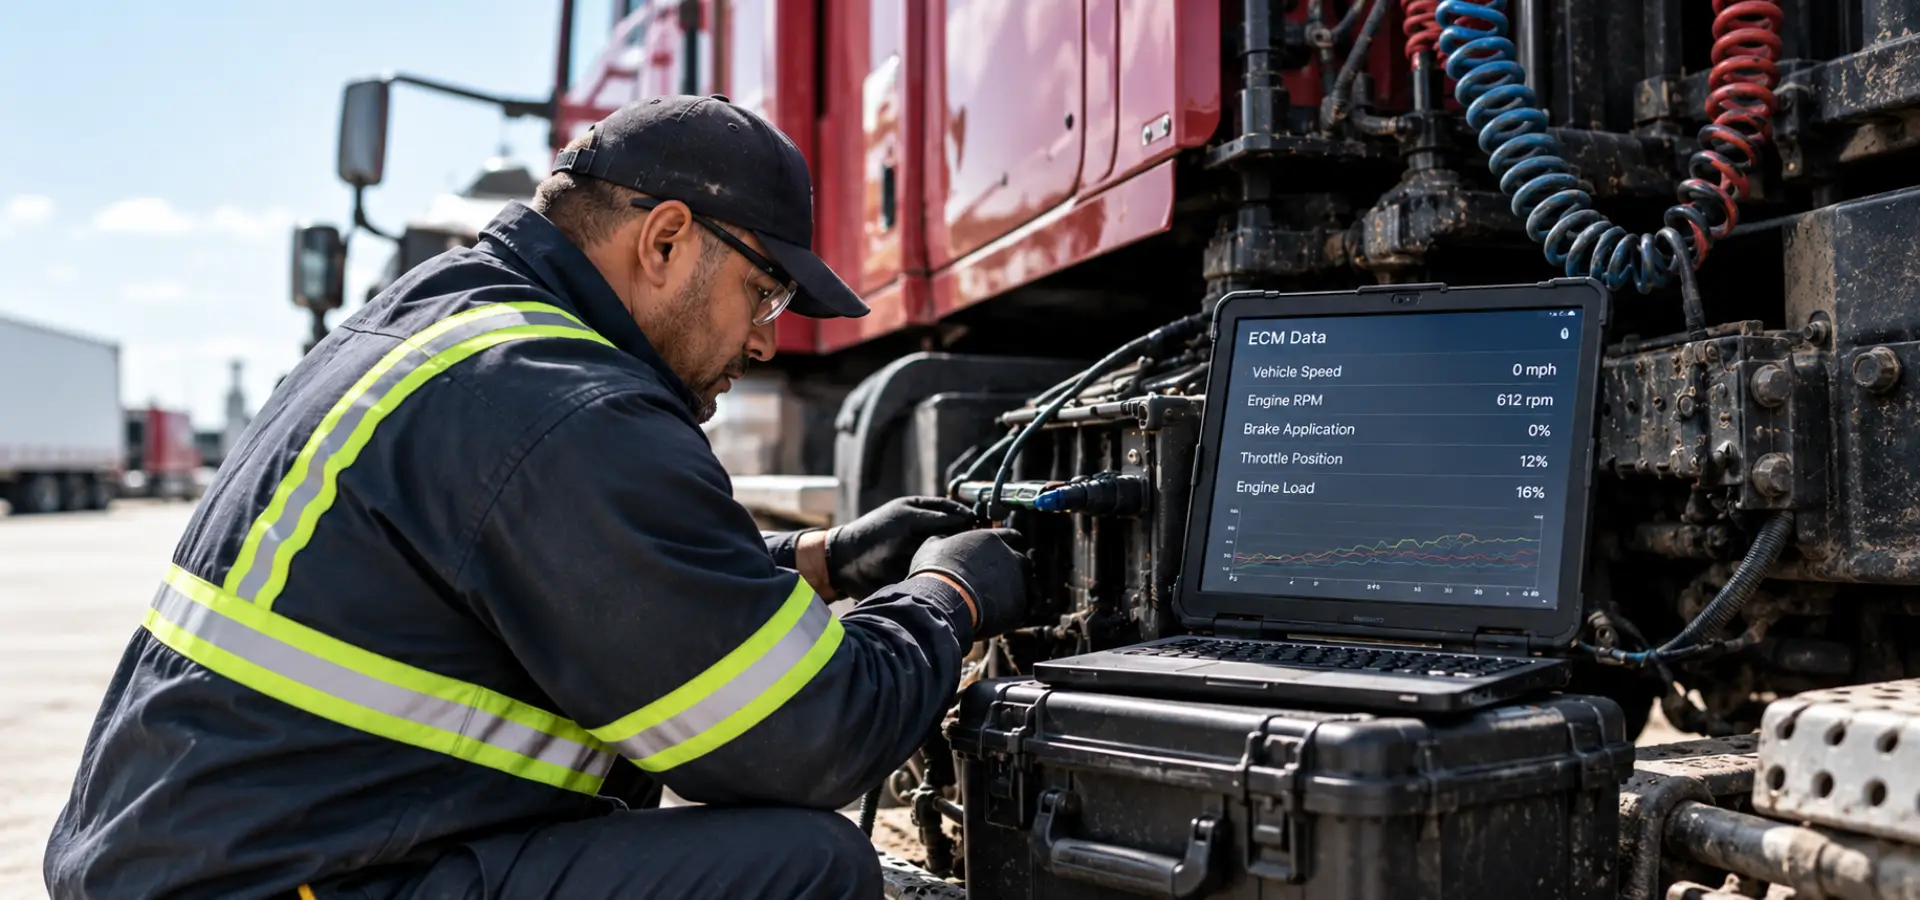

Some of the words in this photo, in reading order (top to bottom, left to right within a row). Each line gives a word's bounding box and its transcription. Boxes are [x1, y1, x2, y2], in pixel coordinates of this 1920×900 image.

[1248, 330, 1286, 346] ECM
[1289, 330, 1327, 345] Data
[1252, 365, 1298, 379] Vehicle
[1300, 365, 1342, 380] Speed
[1512, 363, 1523, 376] 0
[1525, 362, 1557, 379] mph
[1247, 394, 1290, 409] Engine
[1293, 393, 1323, 406] RPM
[1496, 393, 1522, 406] 612
[1525, 396, 1554, 409] rpm
[1243, 422, 1281, 435] Brake
[1282, 422, 1356, 438] Application
[1528, 424, 1551, 437] 0%
[1240, 451, 1289, 465] Throttle
[1291, 452, 1343, 465] Position
[1520, 454, 1548, 468] 12%
[1236, 480, 1280, 496] Engine
[1282, 481, 1316, 494] Load
[1516, 485, 1545, 499] 16%
